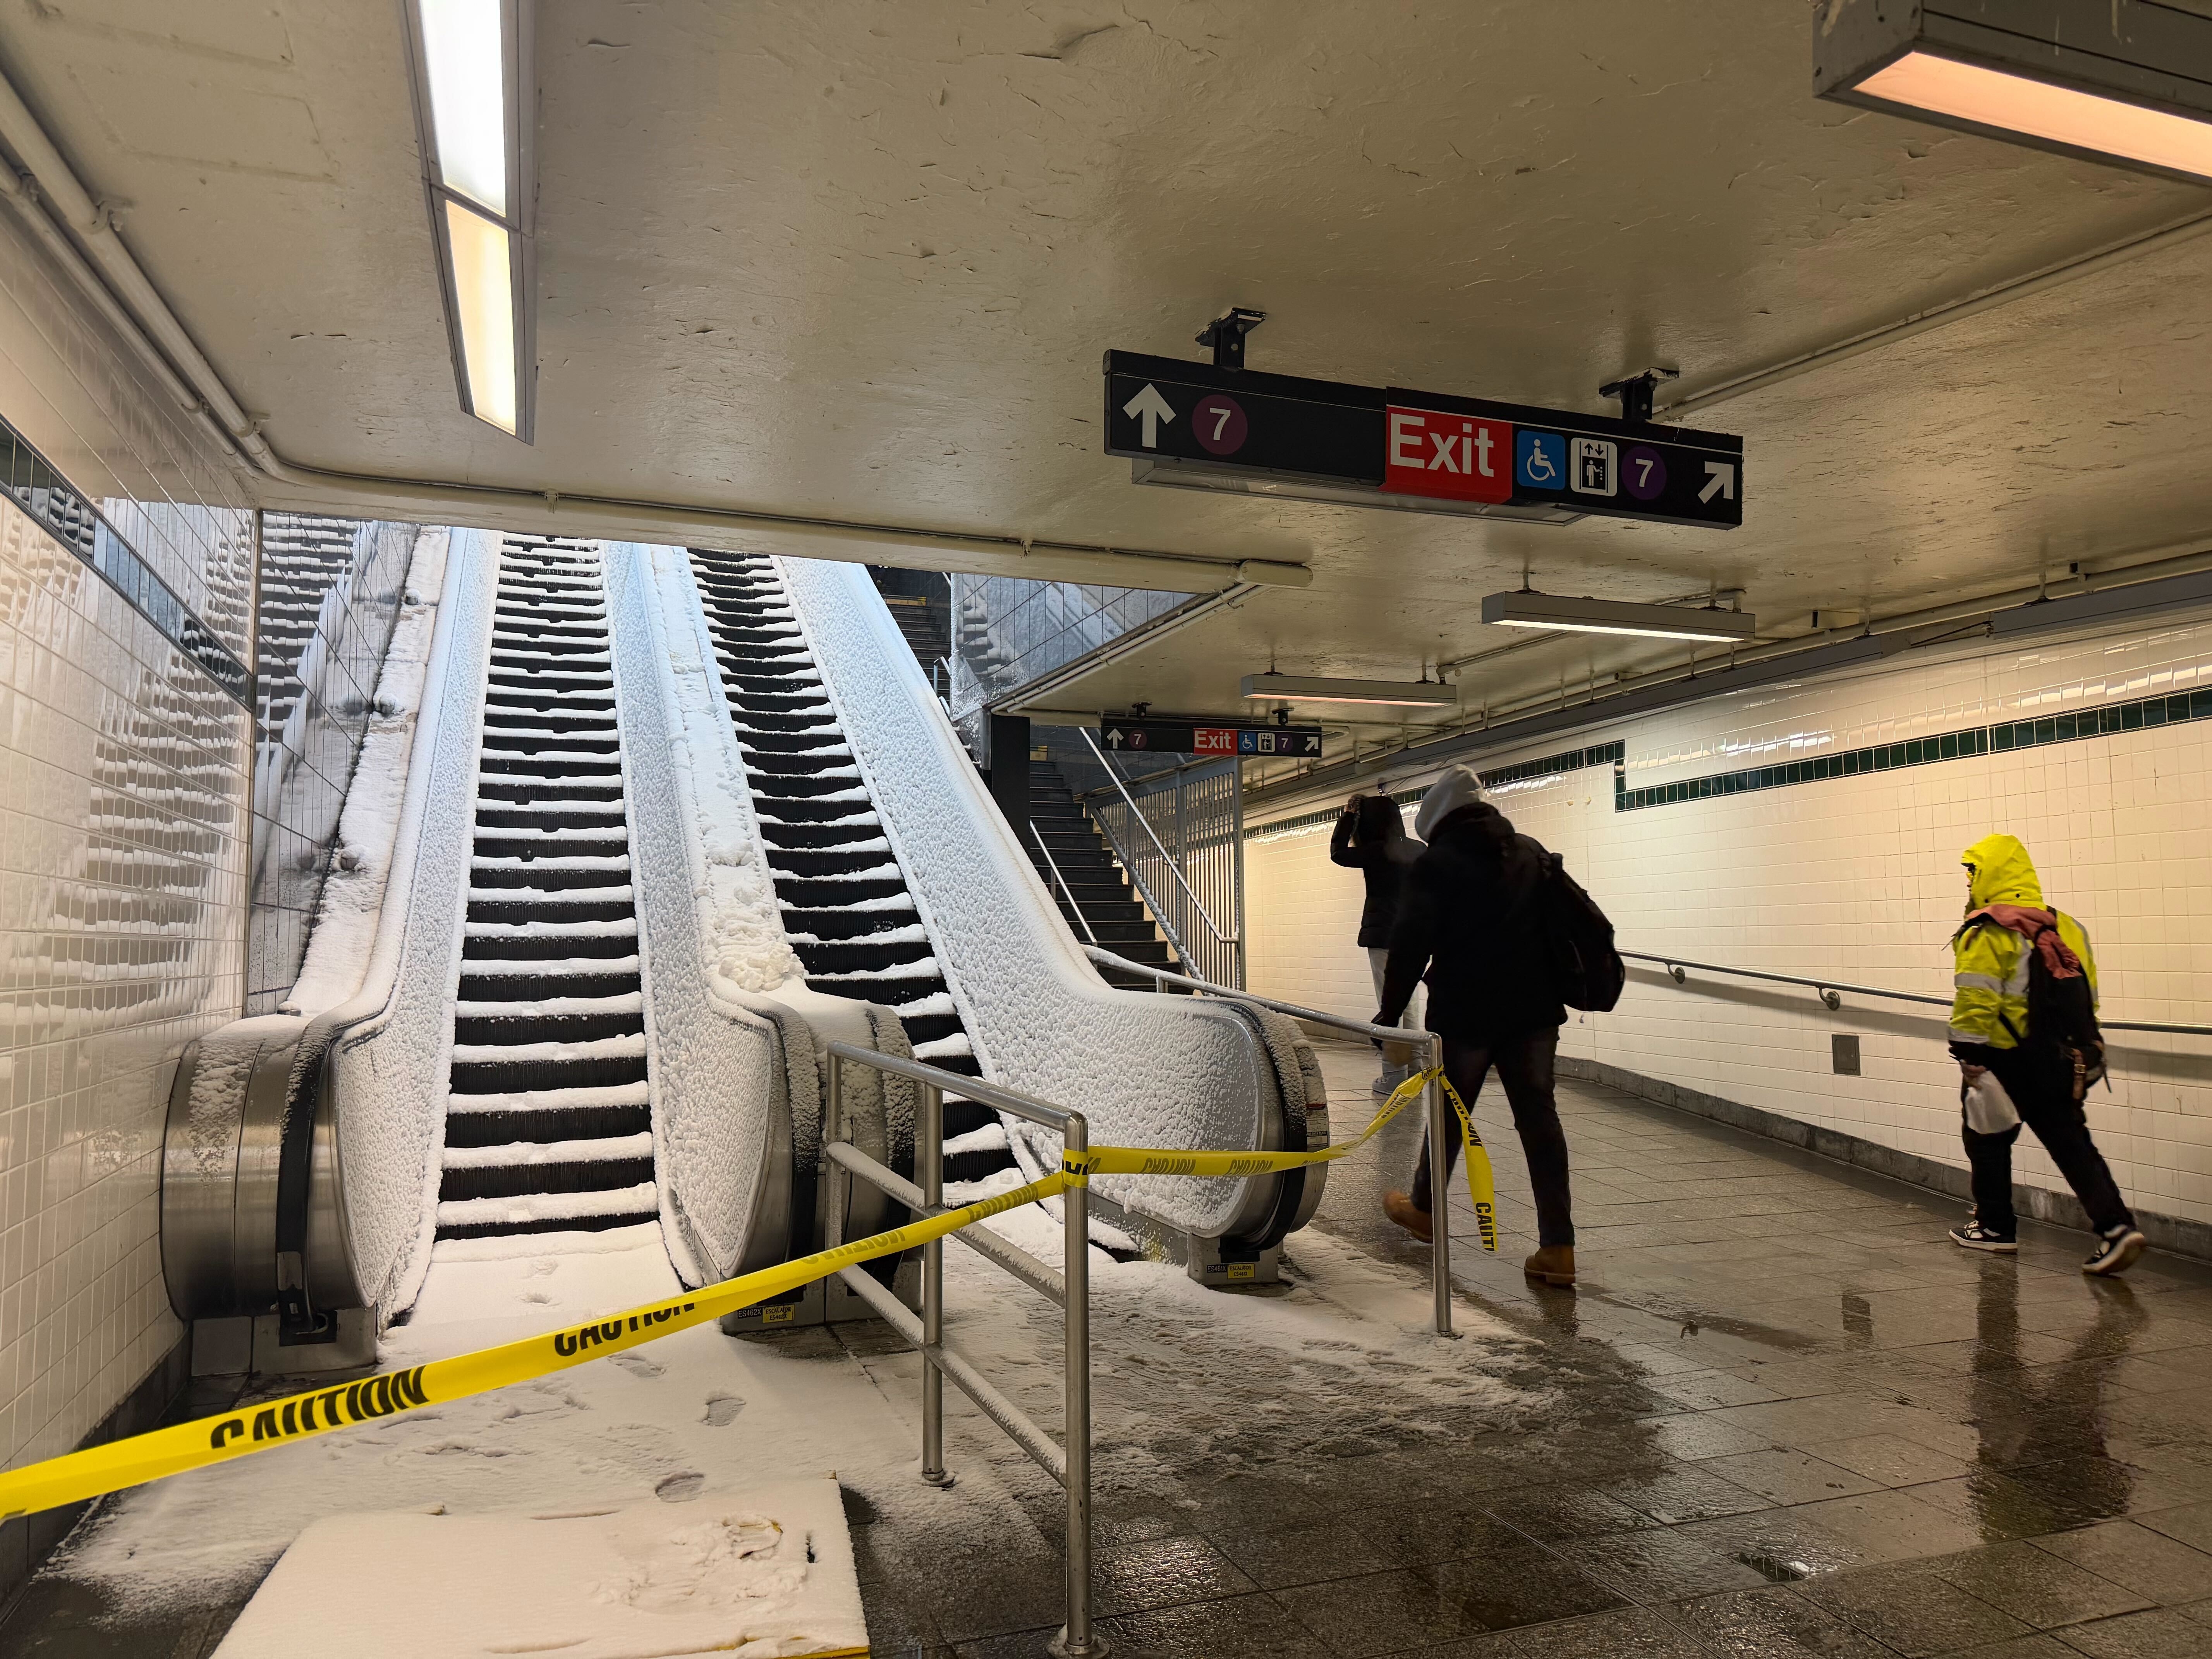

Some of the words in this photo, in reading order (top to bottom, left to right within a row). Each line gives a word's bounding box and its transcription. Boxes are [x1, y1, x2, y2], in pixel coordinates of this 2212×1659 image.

[1209, 407, 1231, 441] 7
[1390, 413, 1494, 477] Exit
[1635, 458, 1654, 488] 7
[1134, 734, 1142, 745] 7
[1195, 730, 1231, 749] Exit
[1281, 738, 1289, 748] 7
[738, 1308, 761, 1317] ES462X
